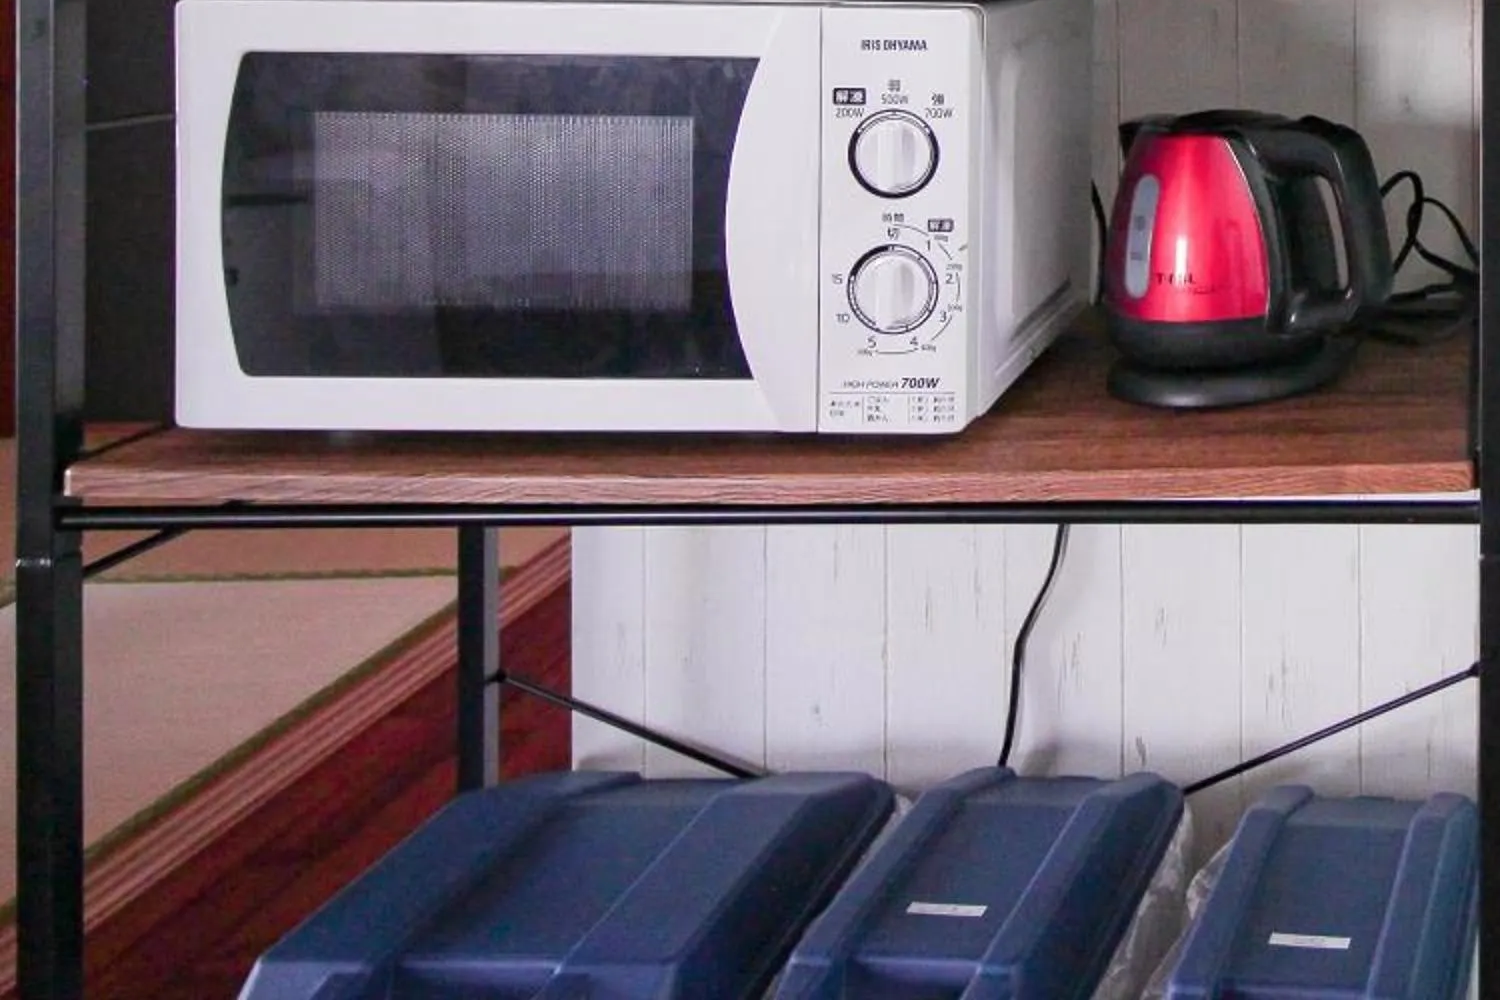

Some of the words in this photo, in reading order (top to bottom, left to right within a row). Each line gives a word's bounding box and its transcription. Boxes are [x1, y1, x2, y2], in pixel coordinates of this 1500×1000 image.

[861, 39, 881, 51] IRIS
[884, 39, 928, 51] OHYAMA
[881, 93, 909, 104] 500W
[835, 107, 865, 118] 200W
[925, 108, 953, 118] 700W
[832, 273, 843, 285] 15
[945, 273, 954, 284] 2
[837, 313, 850, 323] 10
[939, 311, 947, 323] 3
[867, 336, 877, 348] 5
[909, 336, 918, 346] 4
[901, 377, 940, 389] 700W
